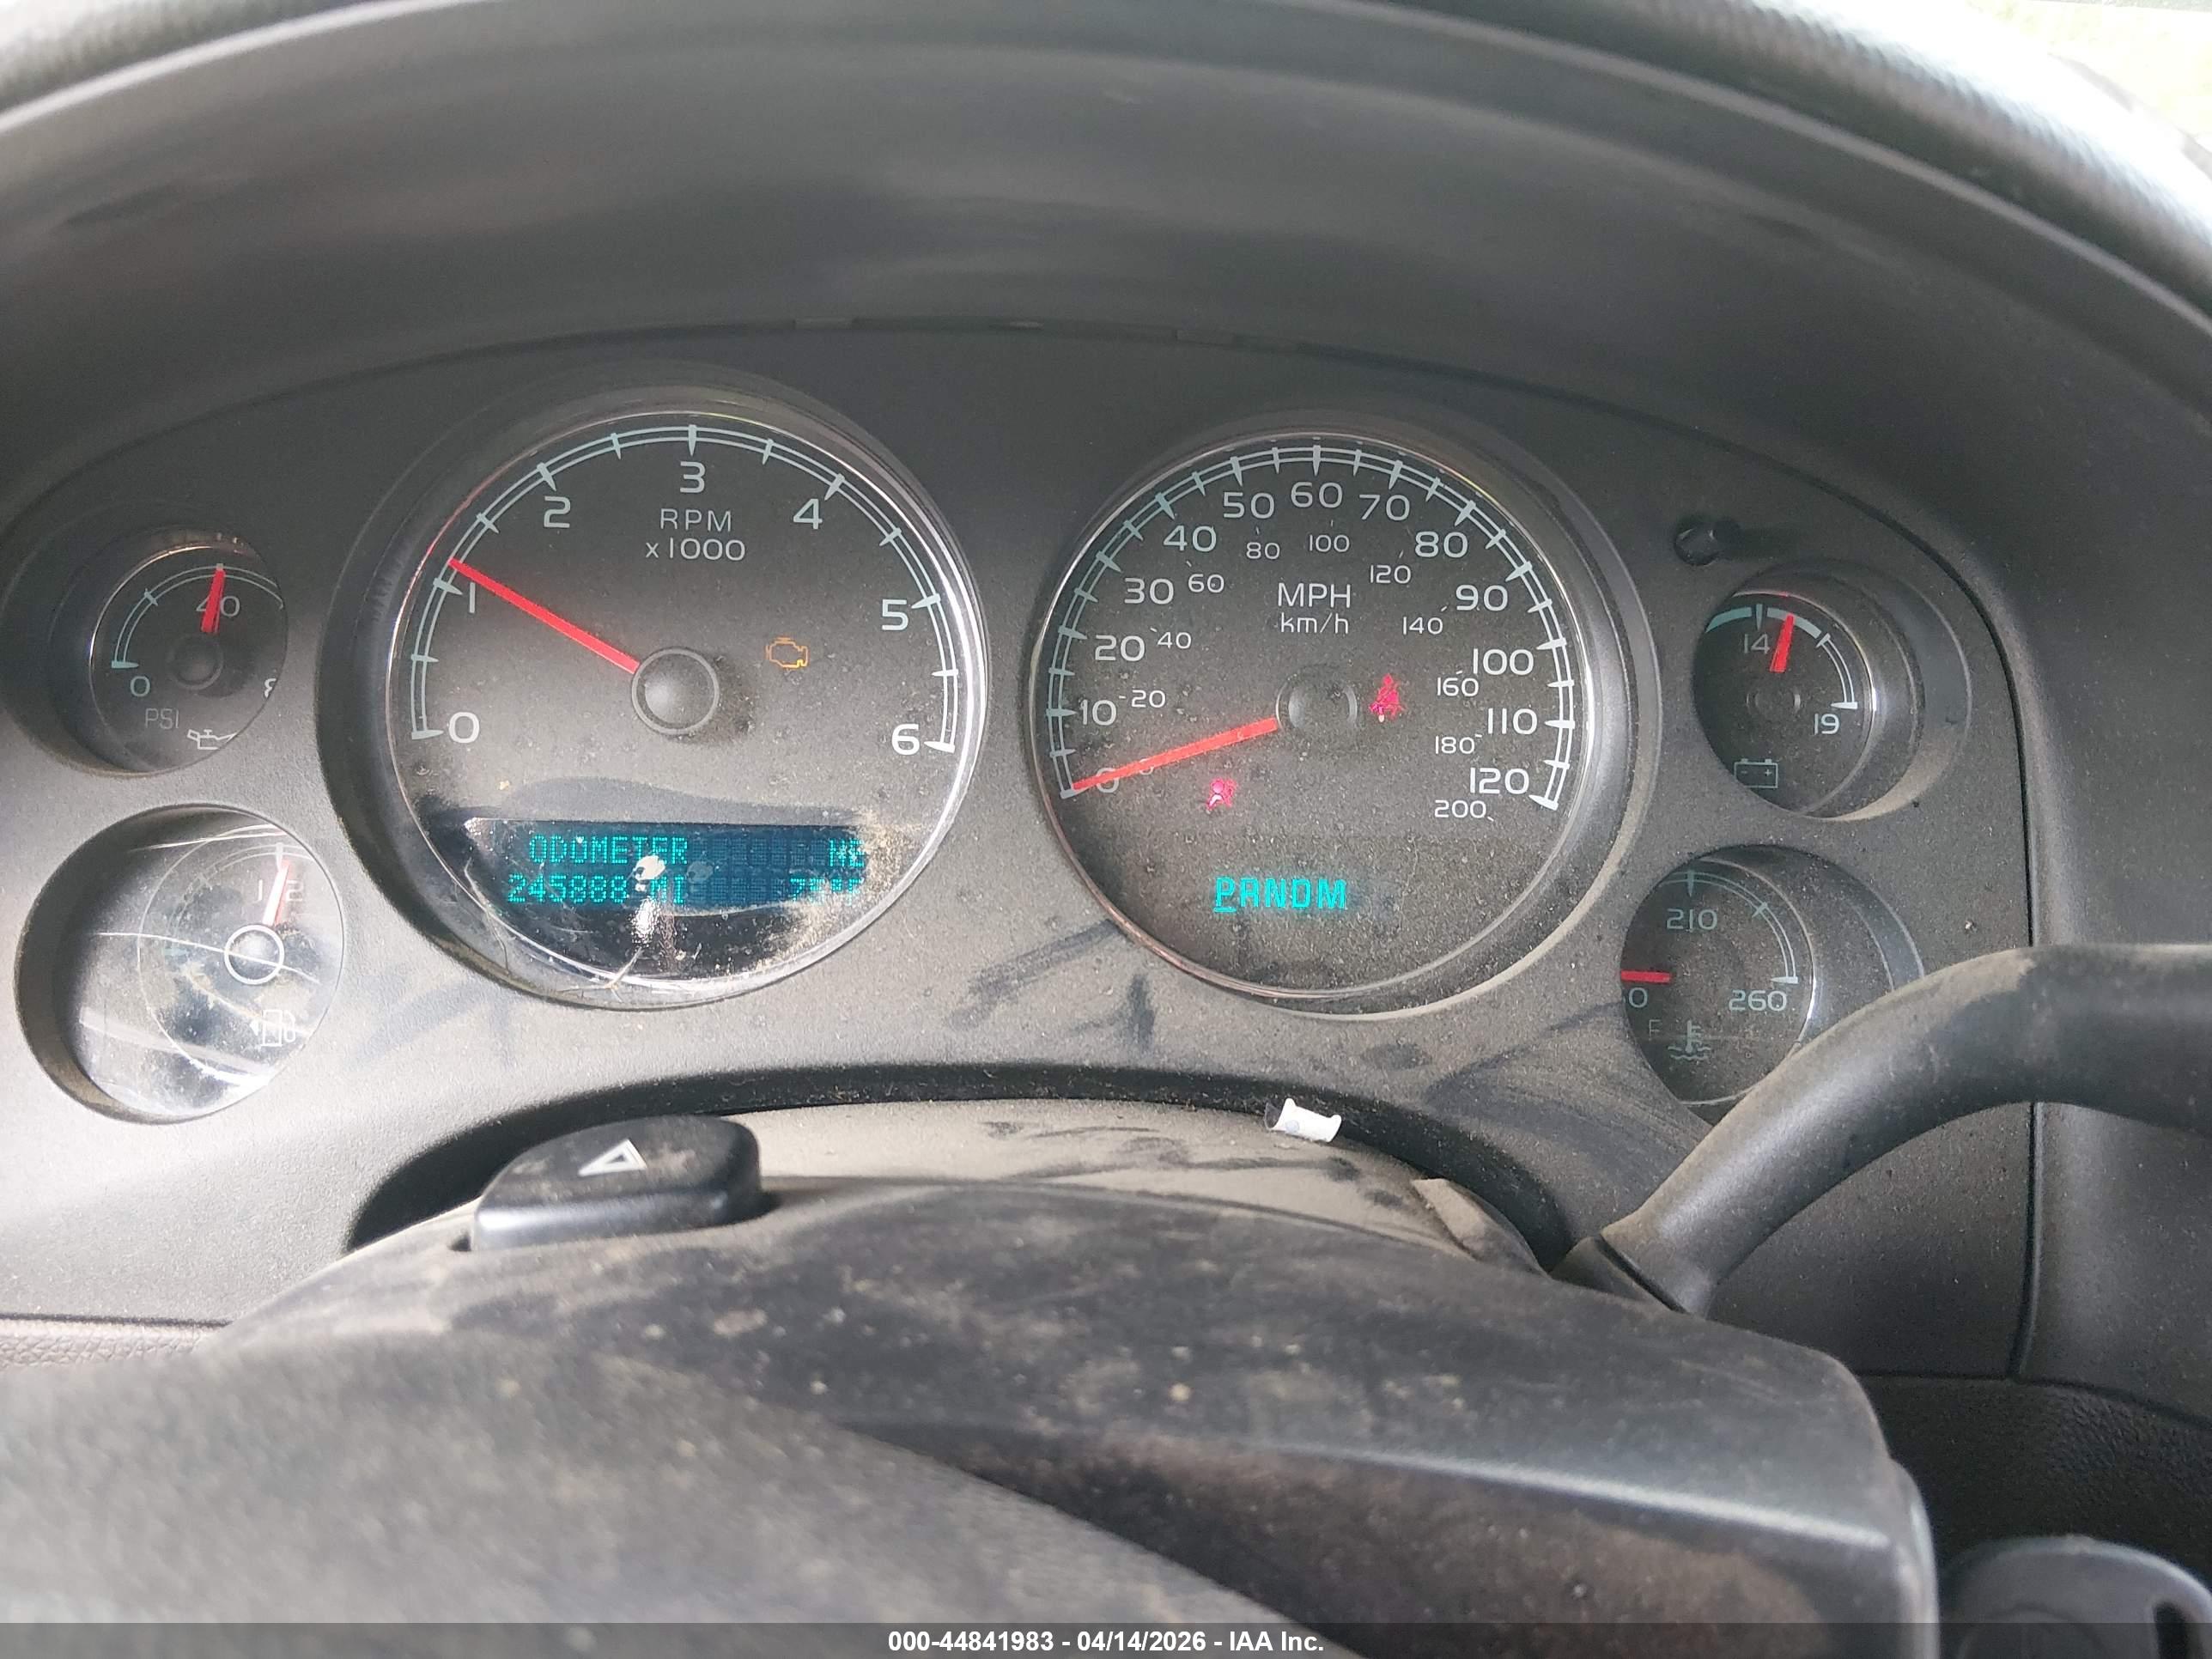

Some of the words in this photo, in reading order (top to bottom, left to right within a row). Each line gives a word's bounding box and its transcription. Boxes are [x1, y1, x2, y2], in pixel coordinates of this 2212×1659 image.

[680, 461, 706, 493] 3
[1223, 491, 1274, 519] 50
[1291, 482, 1343, 508] 60
[1359, 494, 1410, 520] 70
[544, 495, 570, 528] 2
[660, 508, 732, 532] RPM
[793, 498, 822, 529] 4
[1164, 526, 1217, 552] 40
[1246, 542, 1280, 560] 80
[1309, 534, 1350, 553] 100
[1415, 532, 1468, 558] 80
[1188, 574, 1224, 592] 60
[1370, 564, 1412, 584] 120
[467, 582, 477, 615] 1
[1124, 577, 1174, 605] 30
[1278, 582, 1351, 609] MPH
[1455, 584, 1508, 611] 90
[880, 599, 908, 632] 5
[1280, 612, 1349, 635] km/h
[1402, 616, 1443, 635] 140
[1095, 634, 1146, 662] 20
[1158, 631, 1192, 650] 40
[1743, 633, 1771, 655] 14
[1473, 648, 1534, 676] 100
[130, 675, 151, 698] 0
[1131, 689, 1166, 708] 20
[1437, 677, 1480, 697] 160
[144, 708, 179, 730] PSI
[1079, 699, 1117, 726] 10
[1487, 707, 1538, 735] 110
[1814, 714, 1840, 736] 19
[448, 711, 481, 744] 0
[890, 723, 921, 757] 6
[1435, 735, 1475, 755] 180
[1469, 767, 1530, 795] 120
[1434, 799, 1487, 819] 200
[529, 835, 688, 866] ODOMETER
[507, 873, 629, 904] 245888
[1666, 908, 1717, 932] 210
[1728, 988, 1788, 1012] 260
